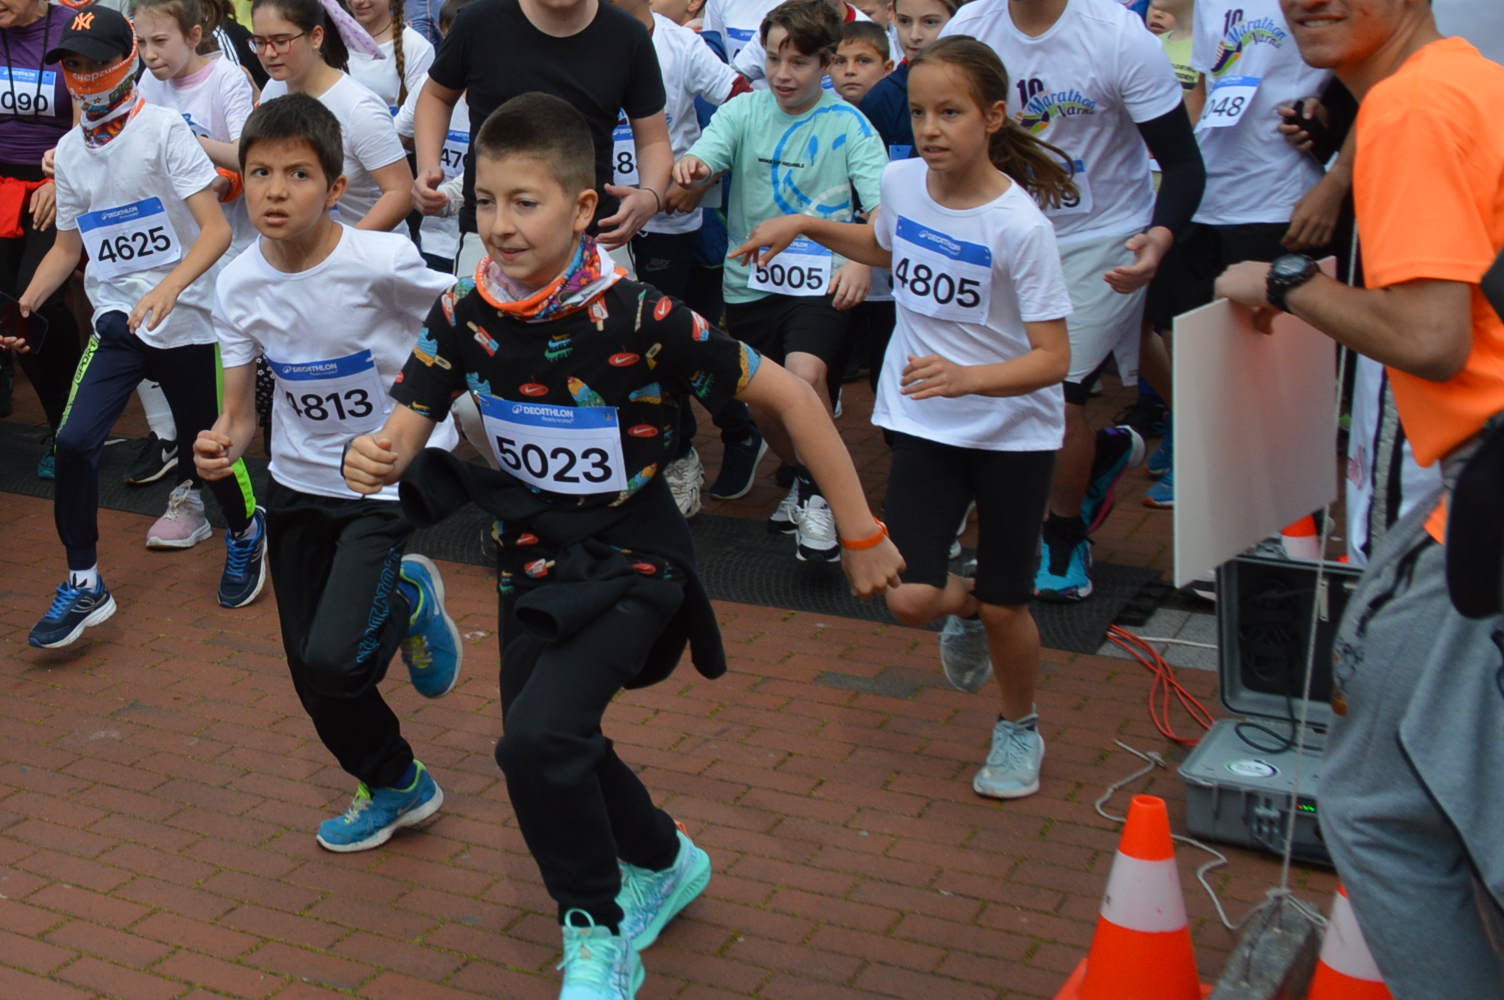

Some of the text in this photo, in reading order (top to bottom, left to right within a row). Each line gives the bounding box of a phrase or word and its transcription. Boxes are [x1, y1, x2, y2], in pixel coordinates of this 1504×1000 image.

[98, 225, 171, 263] 4625
[756, 263, 823, 290] 5005
[895, 257, 981, 308] 4805
[522, 407, 575, 418] DECATHLON
[495, 435, 613, 483] 5023
